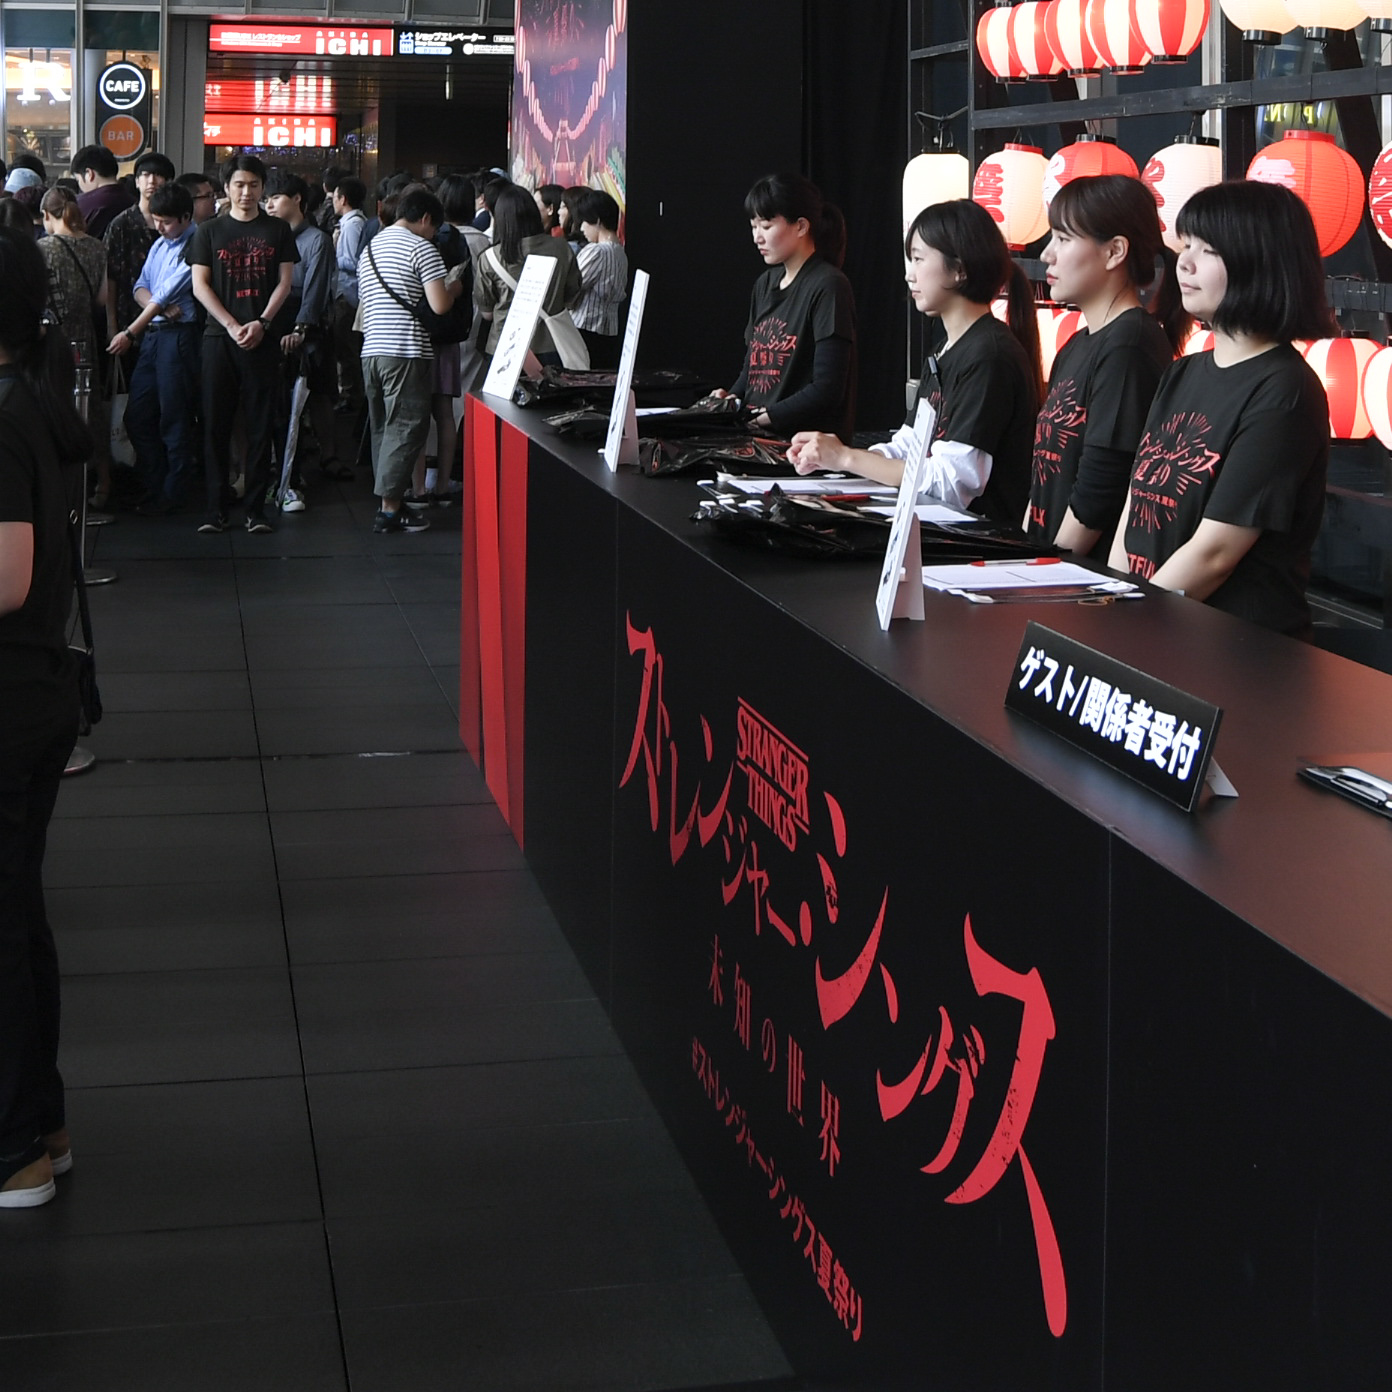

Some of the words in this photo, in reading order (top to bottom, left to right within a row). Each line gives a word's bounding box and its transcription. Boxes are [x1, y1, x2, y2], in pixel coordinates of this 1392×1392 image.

[315, 38, 382, 56] ICHI
[105, 79, 140, 93] CAFE
[108, 130, 135, 141] BAR
[253, 126, 331, 147] ICHI
[1018, 645, 1202, 781] ゲスト/関係者受付
[736, 705, 810, 825] STRANGER
[747, 763, 797, 853] THINGS
[708, 933, 841, 1177] 未知の世界
